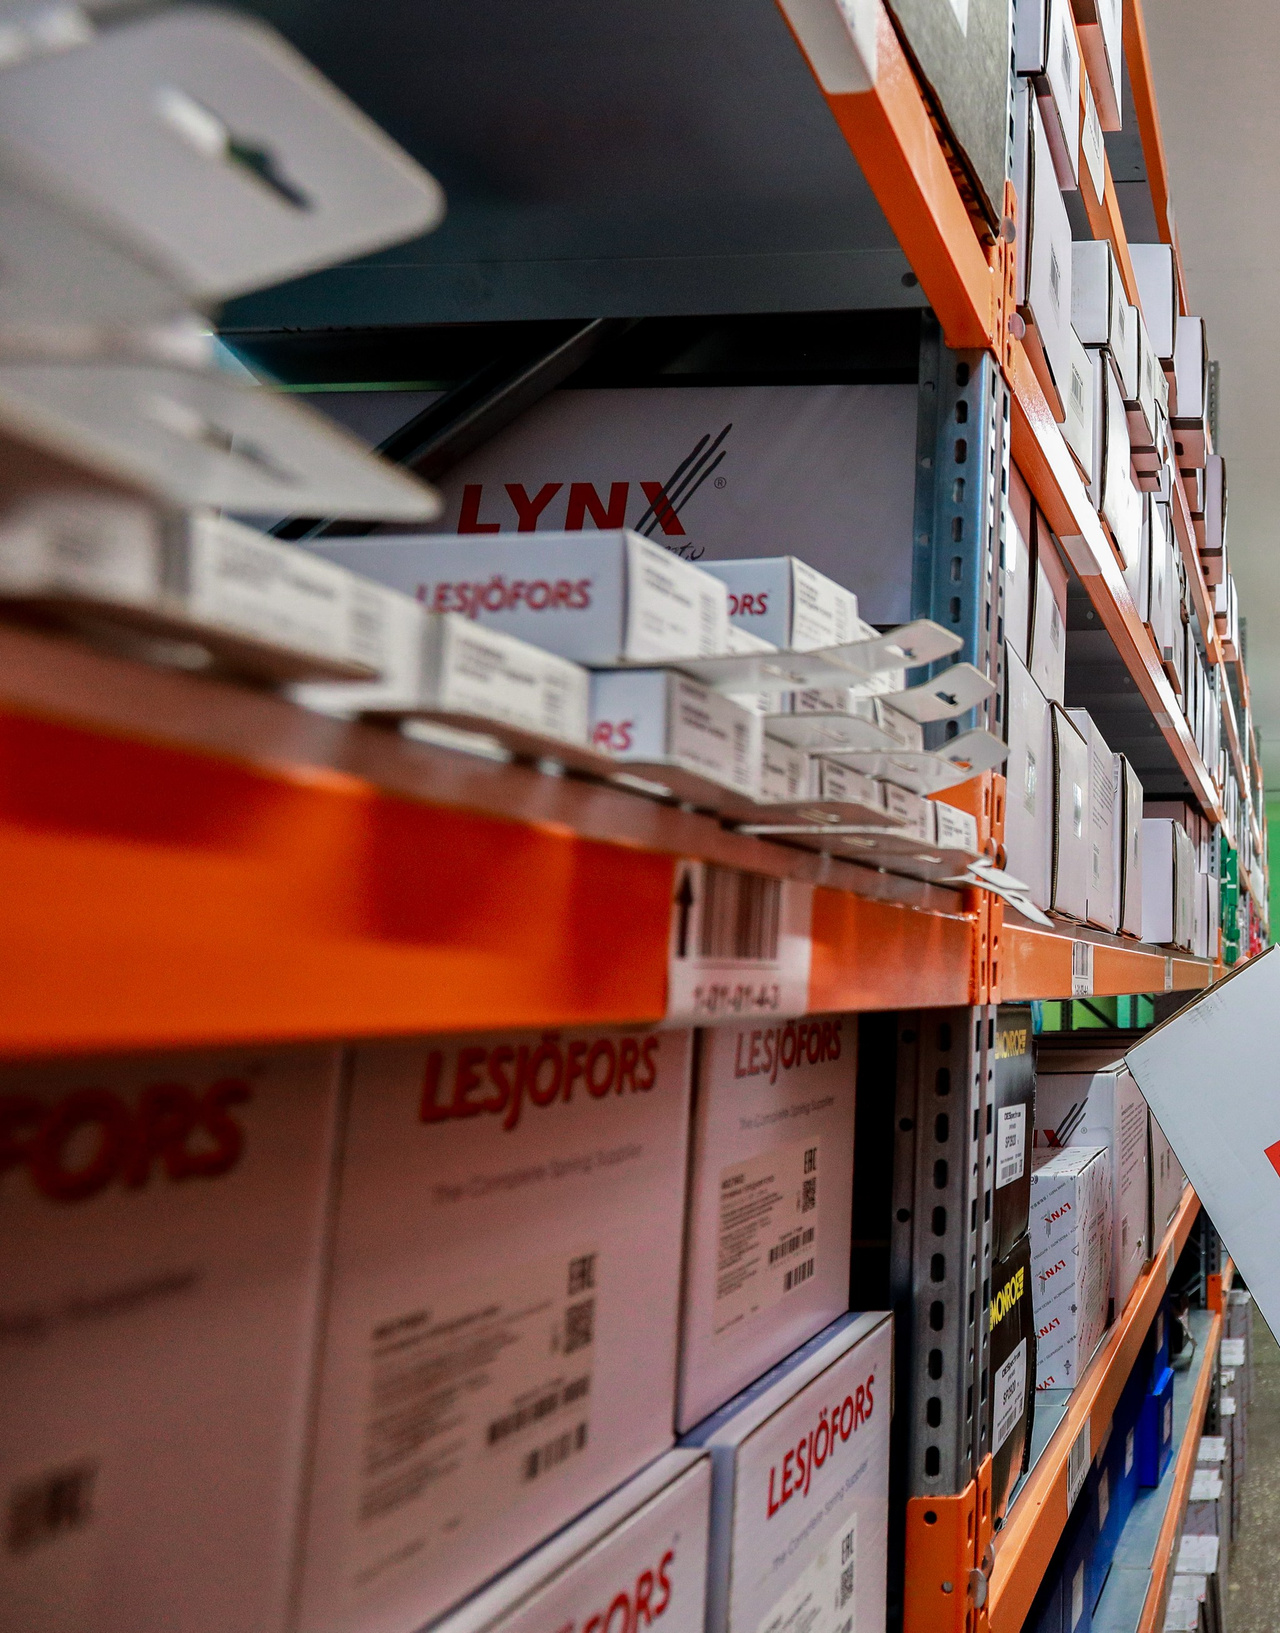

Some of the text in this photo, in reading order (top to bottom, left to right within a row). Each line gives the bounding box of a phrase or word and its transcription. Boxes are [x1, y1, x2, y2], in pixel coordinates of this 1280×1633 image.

[457, 481, 687, 537] LYNX
[734, 1018, 842, 1086] LESJÖFORS
[994, 1028, 1027, 1060] MONROE
[418, 1031, 660, 1132] LESJÖFORS
[990, 1266, 1025, 1332] MONROE
[767, 1373, 875, 1520] LESJÖFORS
